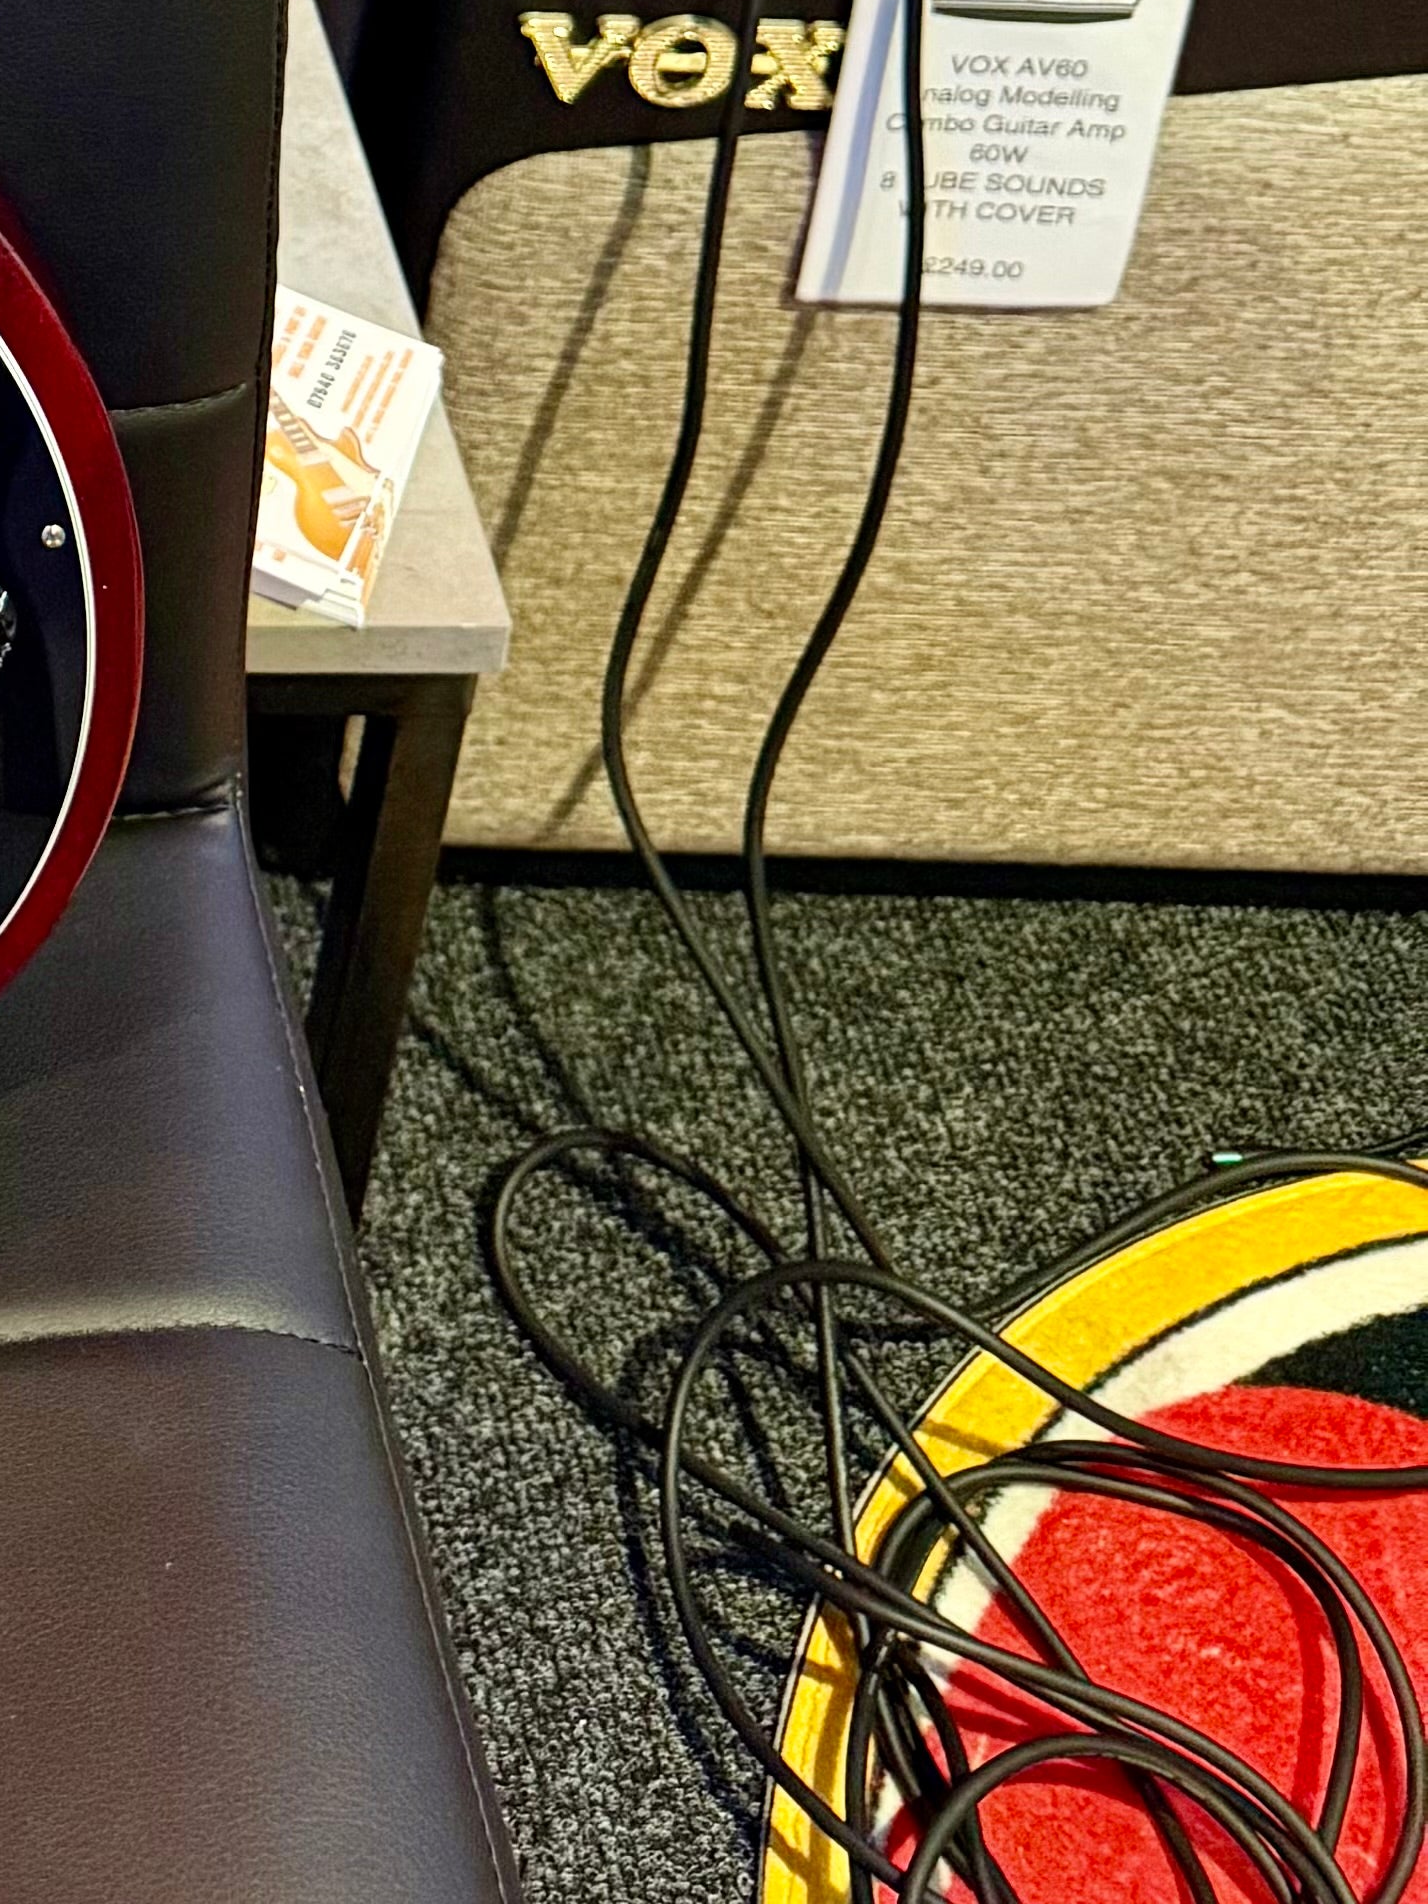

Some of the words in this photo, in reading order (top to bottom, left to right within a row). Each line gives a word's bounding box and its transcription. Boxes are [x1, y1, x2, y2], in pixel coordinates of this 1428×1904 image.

[518, 10, 844, 111] VOX
[951, 54, 1010, 75] VOX
[1016, 58, 1088, 78] AV60
[921, 87, 994, 108] nalog
[999, 86, 1122, 111] Modelling
[886, 113, 975, 132] Cmbo
[982, 114, 1060, 135] Guitar
[1066, 118, 1127, 143] Amp
[969, 143, 1029, 164] 60W
[985, 173, 1107, 197] SOUNDS
[899, 198, 968, 219] TH
[975, 202, 1077, 225] COVER
